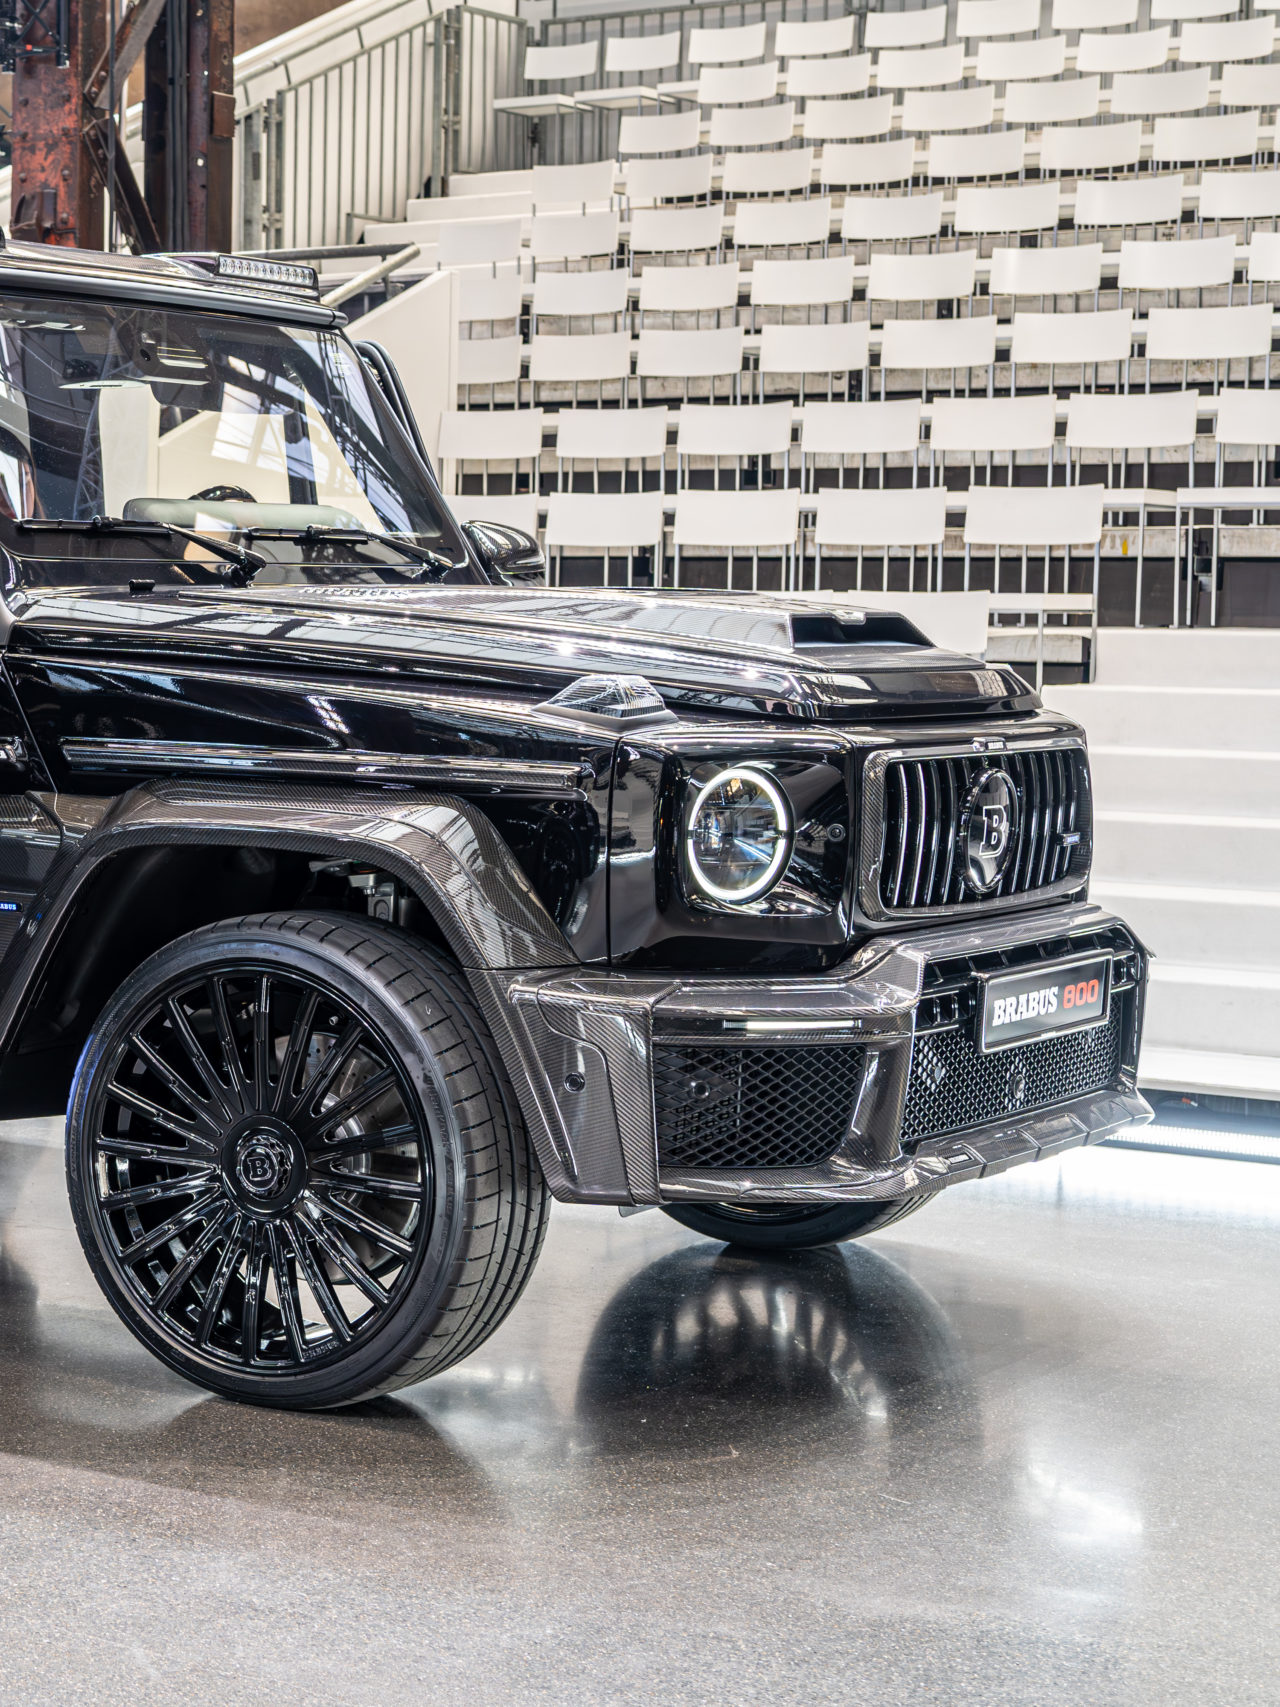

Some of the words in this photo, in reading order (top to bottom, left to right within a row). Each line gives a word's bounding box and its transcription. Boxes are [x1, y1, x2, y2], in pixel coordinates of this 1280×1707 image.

[979, 804, 1007, 858] B
[991, 986, 1058, 1027] BRABUS
[1063, 979, 1099, 1009] 800
[247, 1156, 272, 1180] B
